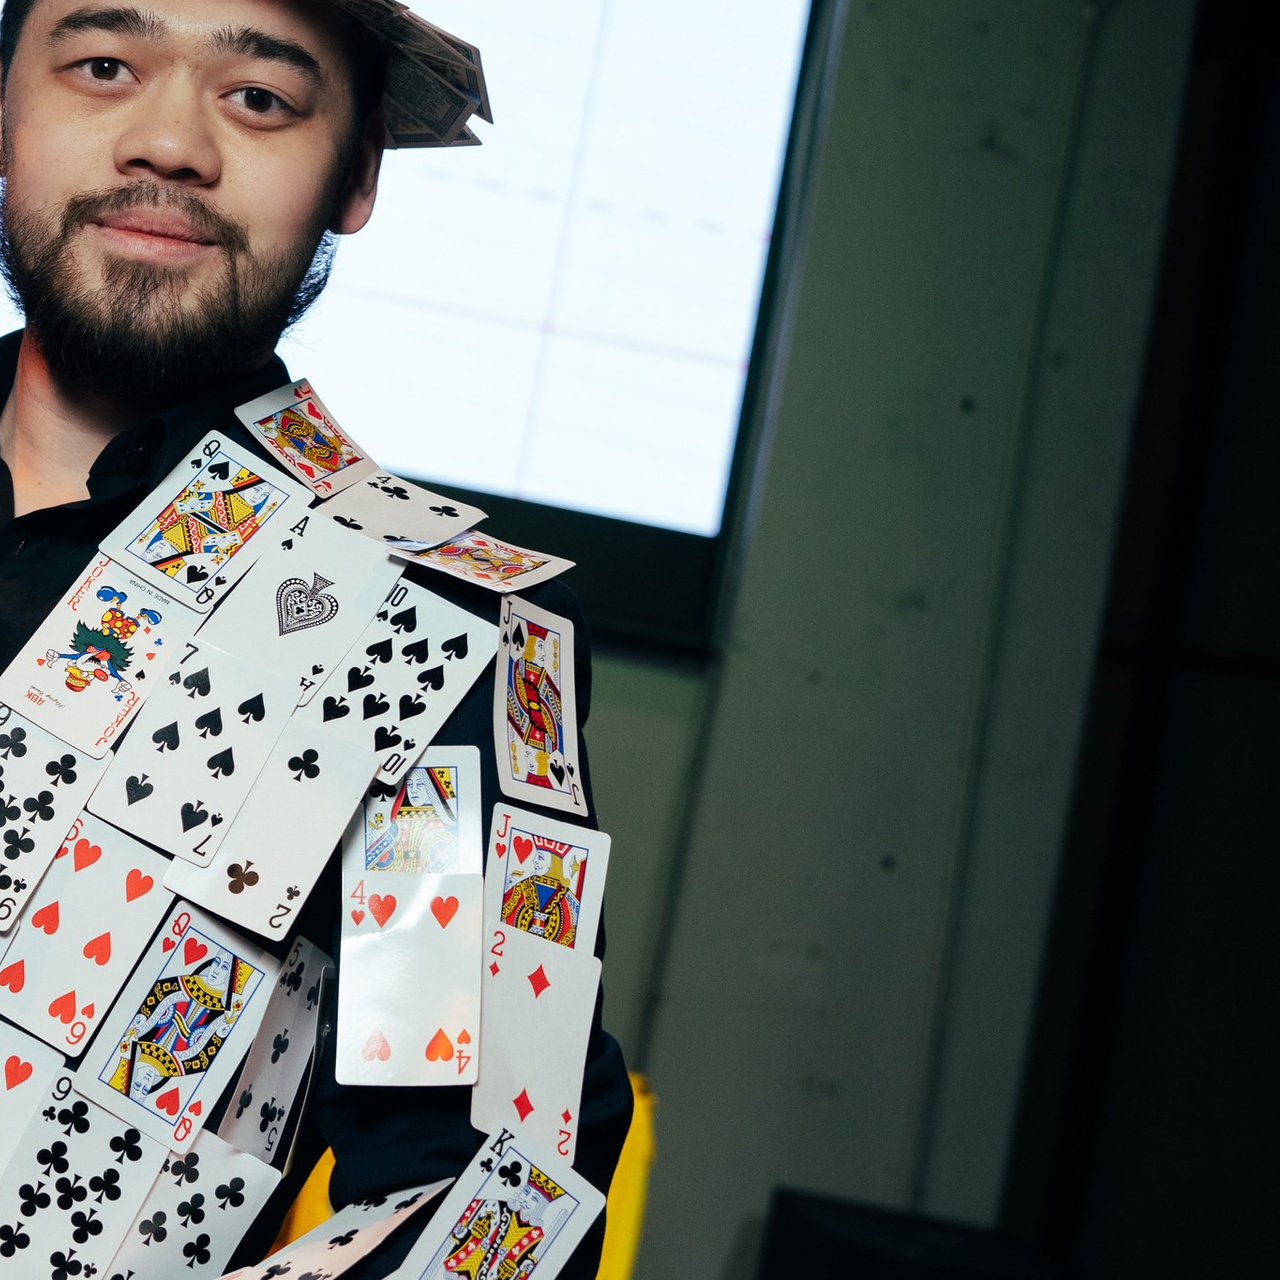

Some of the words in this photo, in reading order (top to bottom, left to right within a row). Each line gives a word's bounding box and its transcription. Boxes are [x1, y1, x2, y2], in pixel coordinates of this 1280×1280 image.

[202, 439, 221, 458] Q
[290, 516, 309, 537] A
[66, 558, 112, 612] JOKER
[129, 578, 148, 592] CHINA
[196, 587, 214, 604] Q
[385, 584, 408, 606] 10
[154, 592, 170, 606] MADE
[504, 601, 512, 624] J
[180, 643, 199, 664] 7
[94, 691, 140, 747] JOKER
[382, 752, 407, 776] 10
[572, 784, 580, 806] J
[497, 814, 511, 838] J
[193, 835, 212, 856] 7
[351, 880, 366, 904] 4
[172, 912, 190, 937] Q
[269, 904, 291, 928] 2
[288, 943, 303, 964] 5
[491, 931, 505, 956] 2
[456, 1050, 471, 1074] 4
[52, 1077, 72, 1101] 9
[174, 1116, 192, 1141] Q
[265, 1127, 277, 1152] 5
[490, 1128, 516, 1157] K
[558, 1130, 571, 1155] 2
